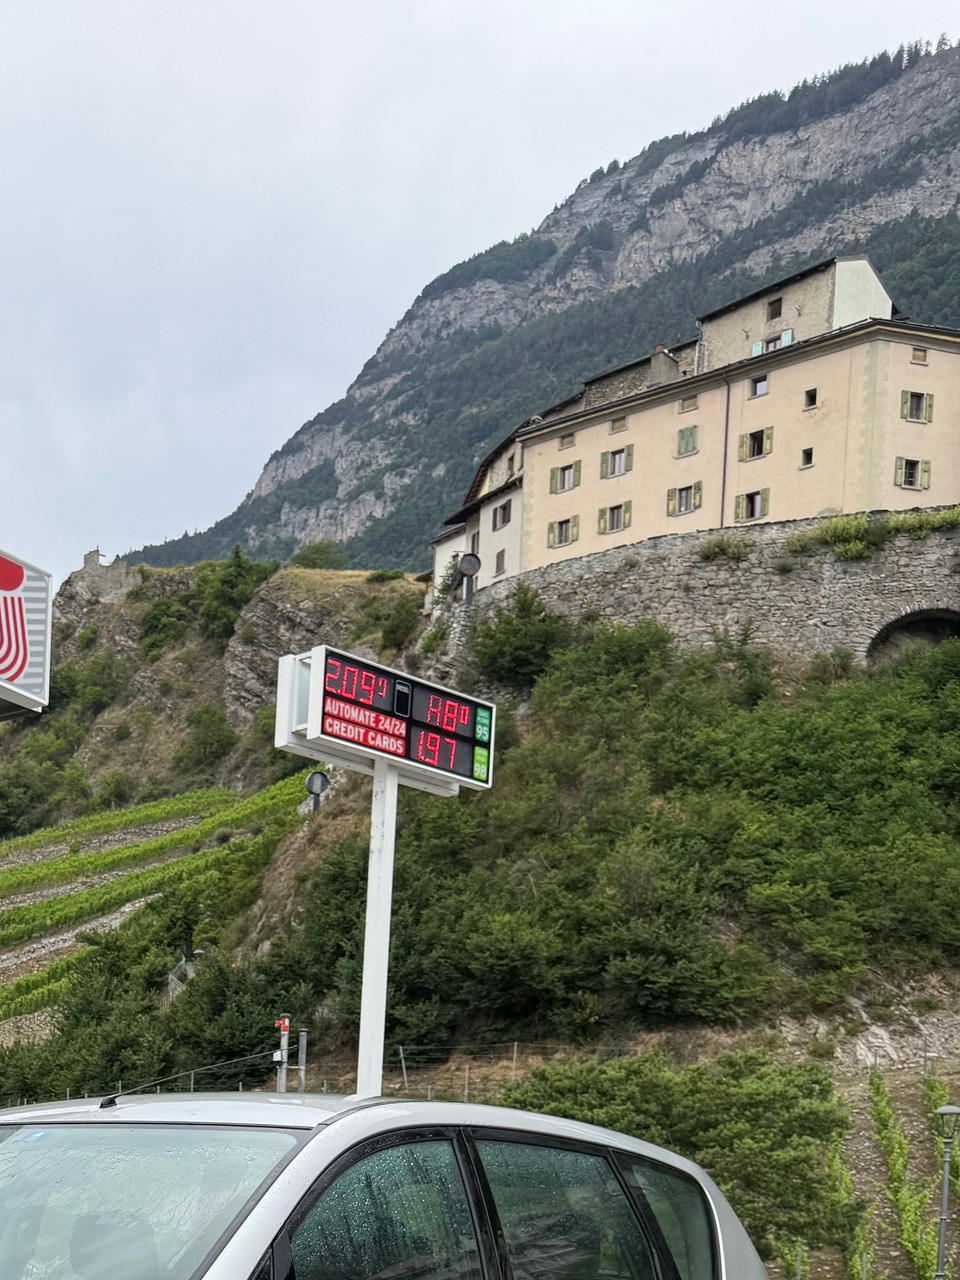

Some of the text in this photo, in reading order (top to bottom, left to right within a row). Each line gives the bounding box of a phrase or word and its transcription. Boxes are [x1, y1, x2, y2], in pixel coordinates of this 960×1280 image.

[324, 698, 407, 736] AUTOMATE 24/24
[325, 718, 404, 754] CREDIT CARDS
[476, 724, 489, 741] 95
[473, 762, 487, 779] 98
